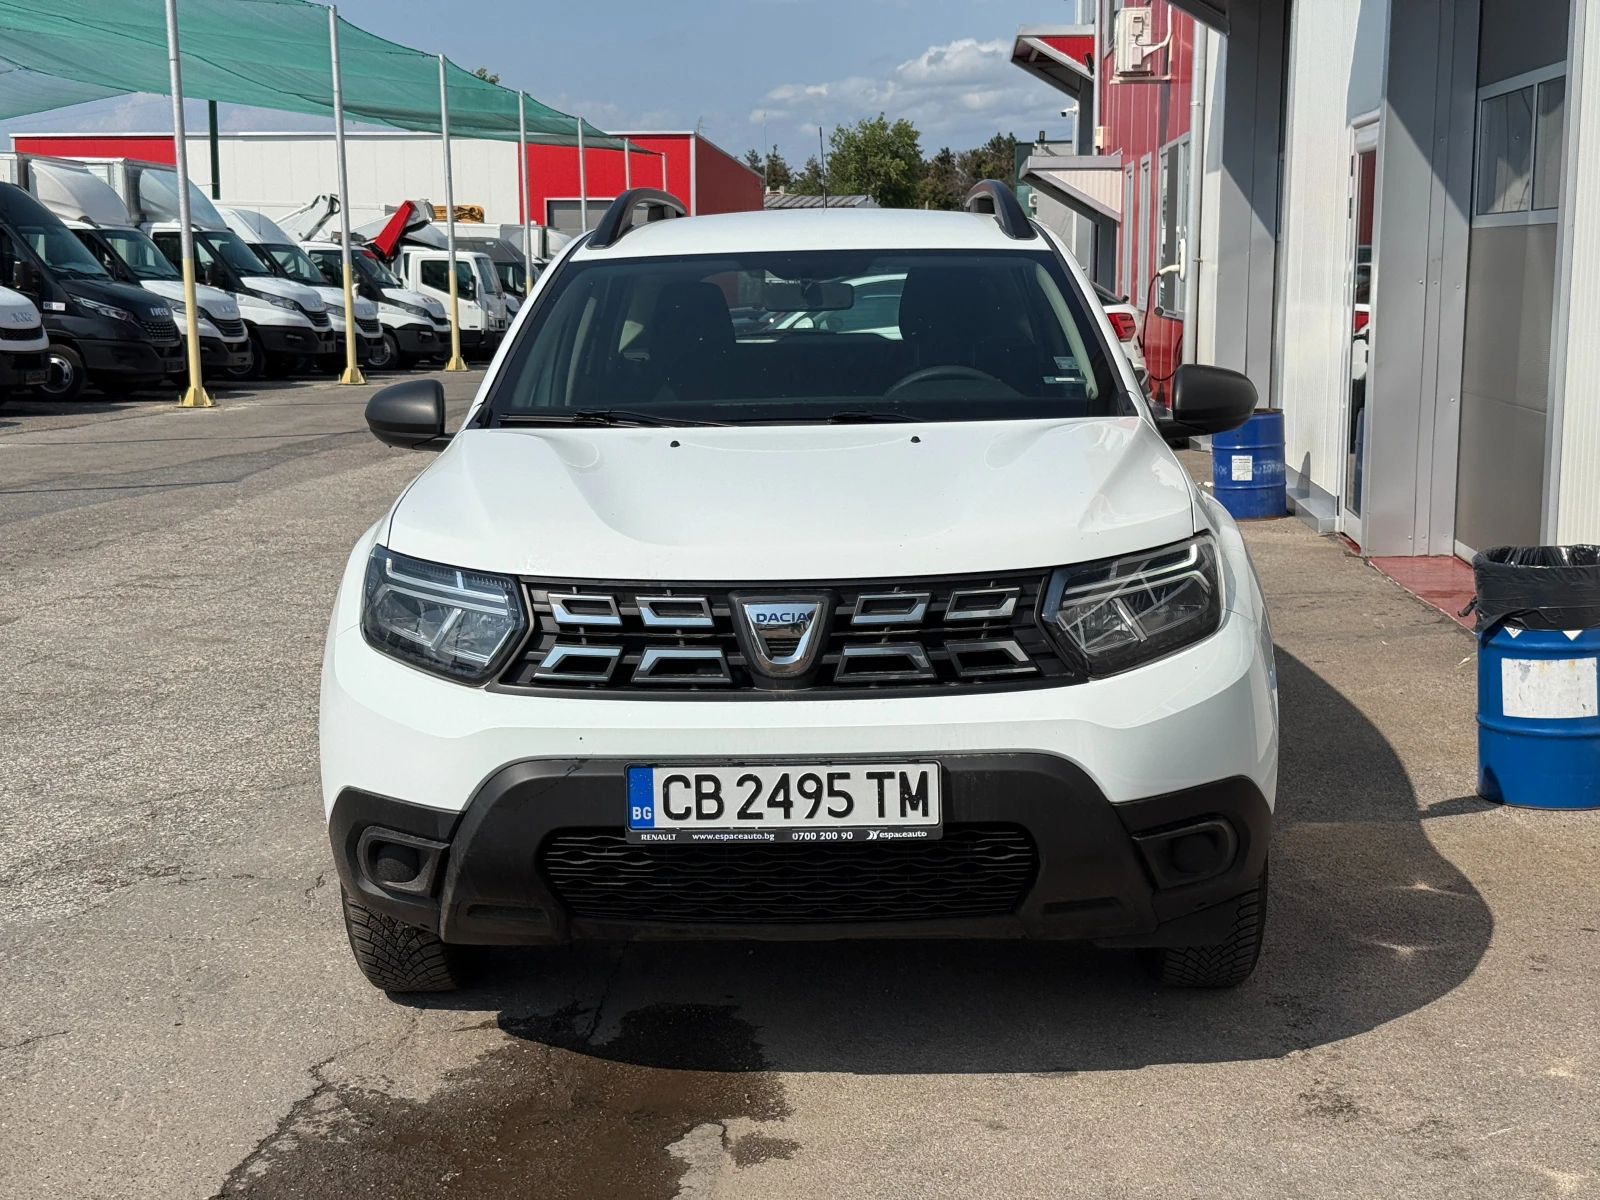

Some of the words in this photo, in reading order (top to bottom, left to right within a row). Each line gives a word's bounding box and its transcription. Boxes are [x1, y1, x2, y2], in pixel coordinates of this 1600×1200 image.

[756, 612, 809, 623] DACIA
[662, 774, 724, 820] CB
[736, 772, 854, 820] 2495
[866, 771, 929, 818] TM
[632, 806, 652, 820] BG
[641, 833, 677, 841] RENAULT
[692, 832, 775, 841] www.espaceauto.bg
[792, 832, 816, 840] 0700
[819, 832, 838, 840] 200
[841, 831, 853, 840] 90
[879, 831, 928, 839] espaceauto
